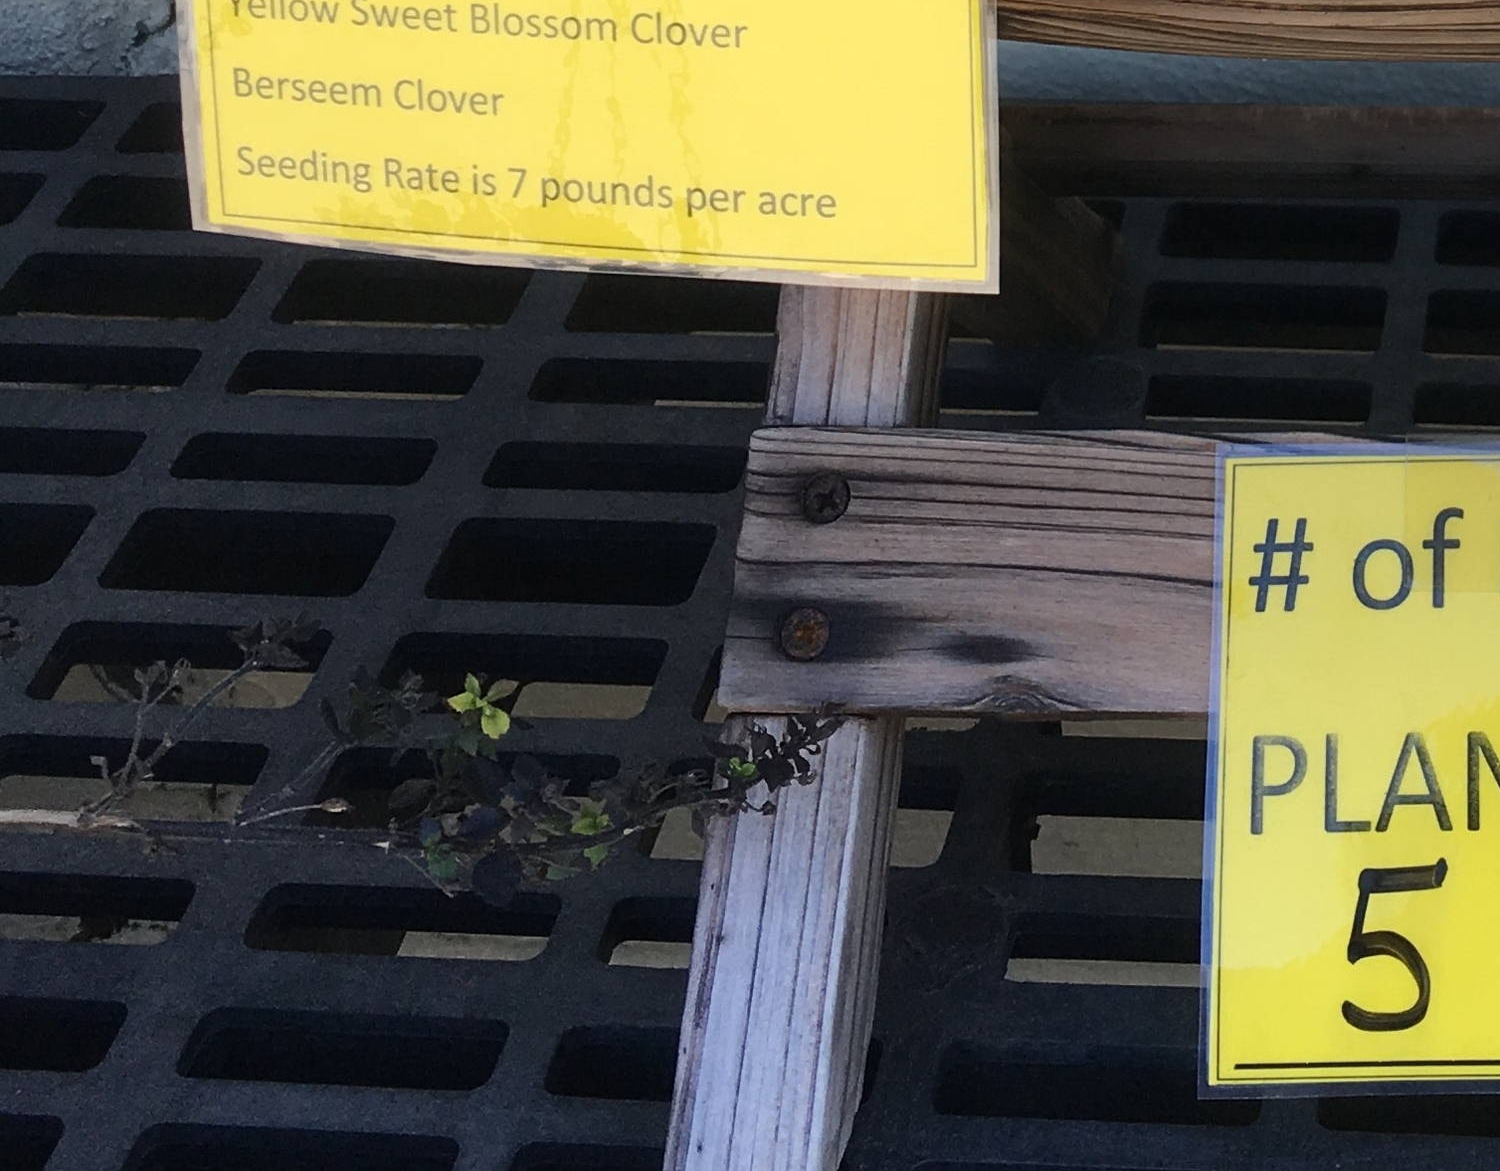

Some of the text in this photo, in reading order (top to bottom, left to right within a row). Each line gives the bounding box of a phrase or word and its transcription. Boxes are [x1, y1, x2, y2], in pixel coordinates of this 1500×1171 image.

[470, 3, 617, 44] Blossom
[629, 12, 748, 50] Clover
[231, 67, 504, 117] Berseem Clover
[236, 145, 838, 220] Seeding Rate is 7 pounds per acre
[1248, 517, 1315, 614] #
[1351, 507, 1465, 611] of
[1341, 857, 1449, 1033] 5
